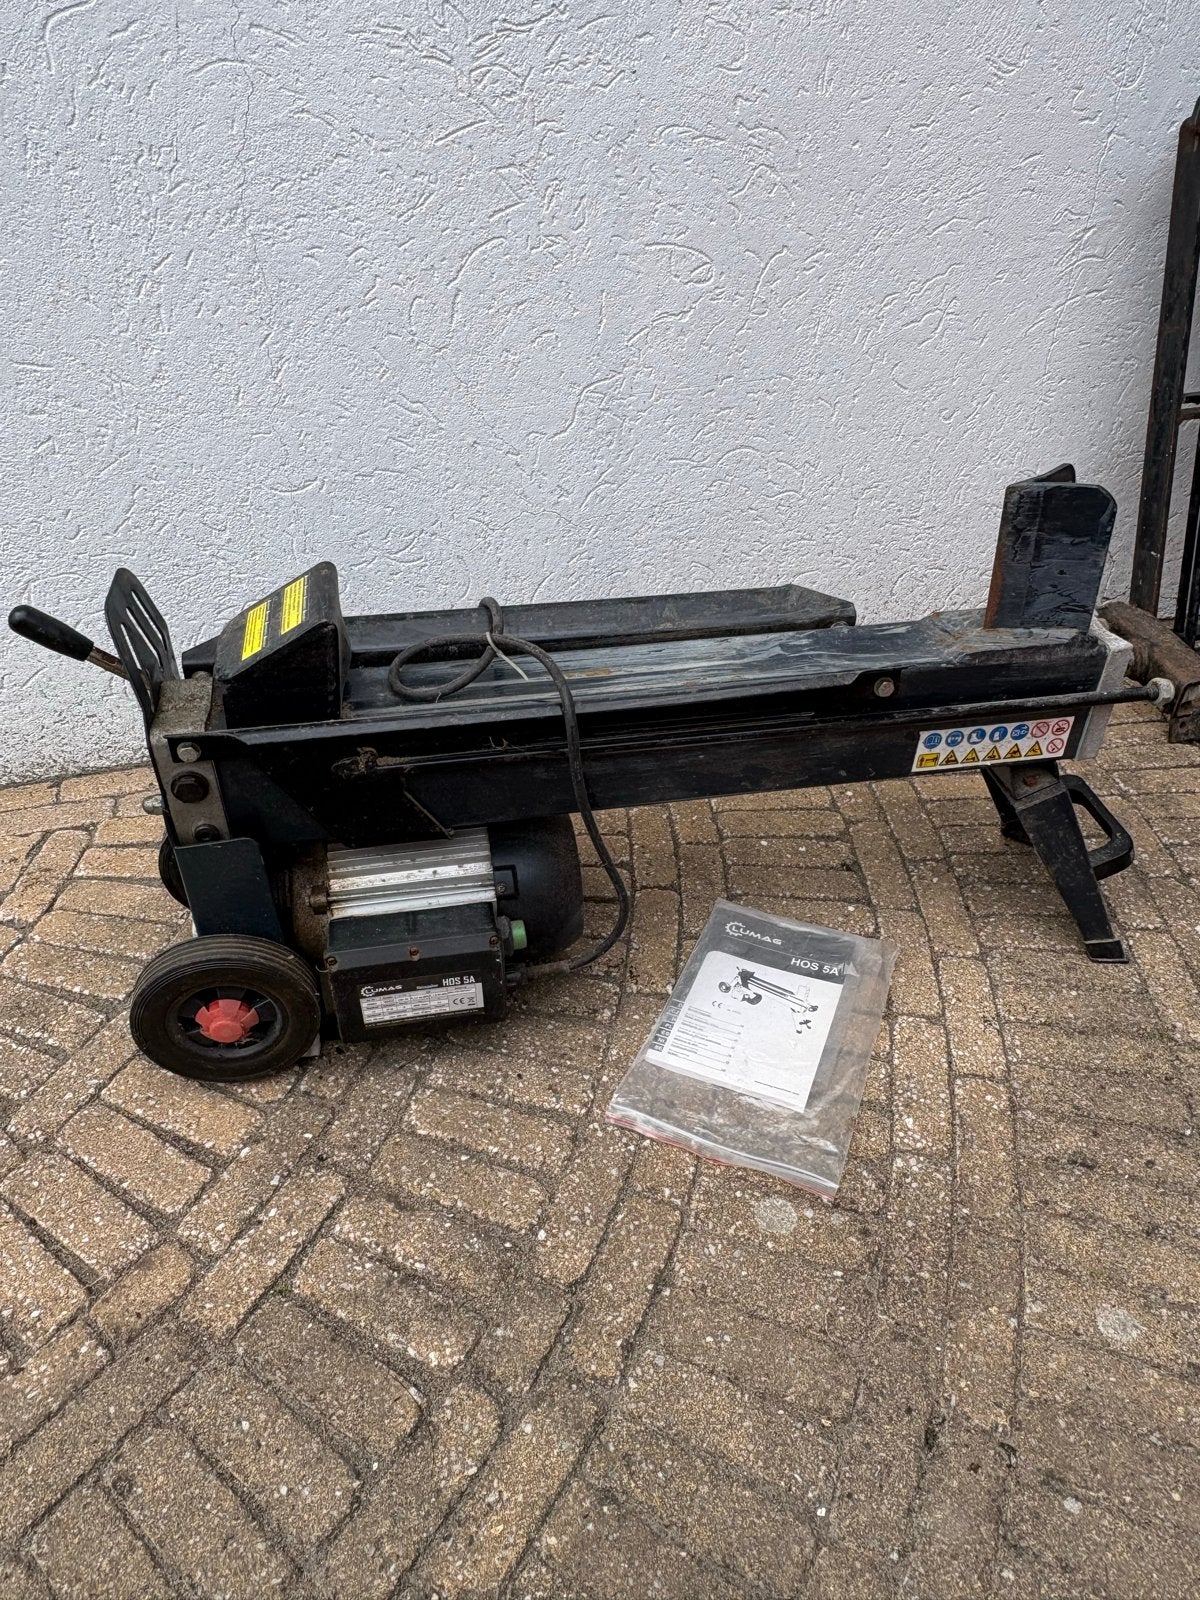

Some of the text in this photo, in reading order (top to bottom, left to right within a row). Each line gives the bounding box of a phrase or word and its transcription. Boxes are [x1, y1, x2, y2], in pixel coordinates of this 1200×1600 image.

[727, 922, 782, 945] LUMAG
[790, 957, 839, 976] HOS 5A
[442, 978, 461, 987] HOS
[463, 975, 476, 984] 5A
[362, 984, 403, 996] LUMAG
